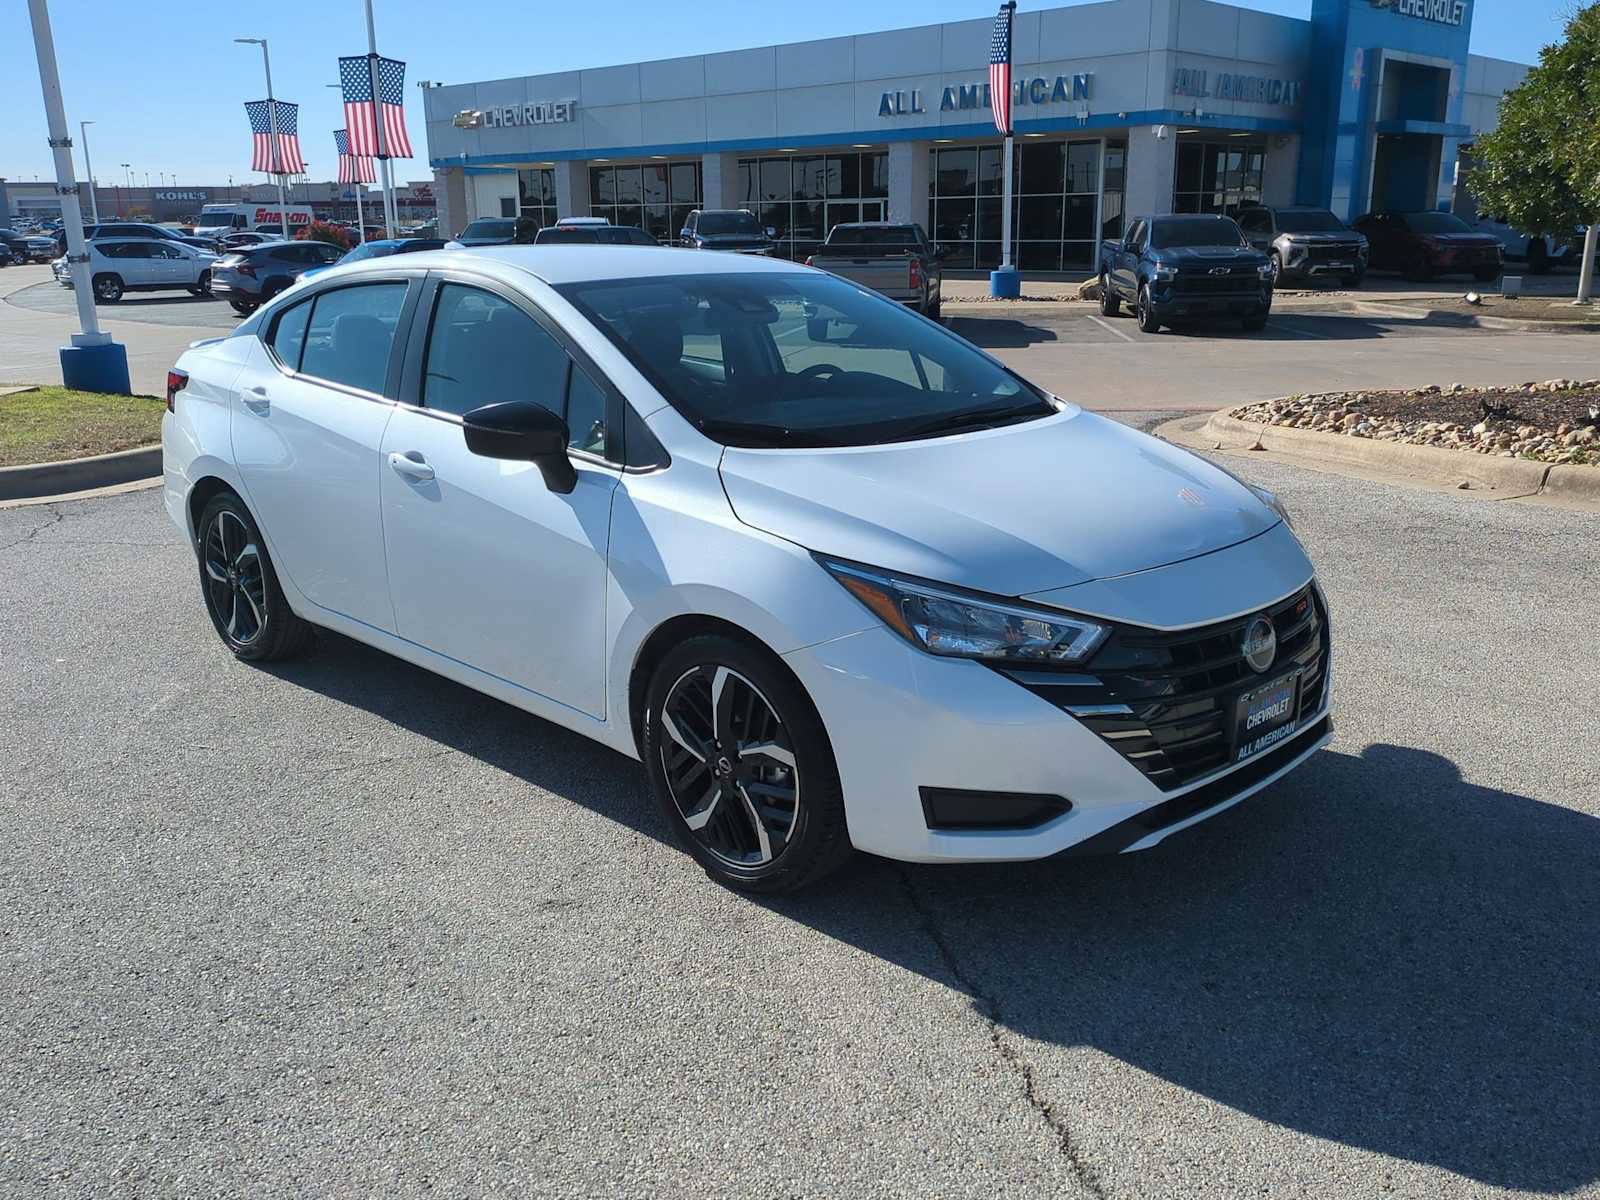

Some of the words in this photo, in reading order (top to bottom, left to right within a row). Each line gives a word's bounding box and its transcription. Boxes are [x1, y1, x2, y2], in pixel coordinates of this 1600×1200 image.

[1399, 0, 1466, 26] CHEVROLET
[1174, 68, 1209, 97] ALL
[483, 100, 576, 128] CHEVROLET
[878, 89, 924, 116] ALL
[155, 192, 207, 200] KOHL'S
[1246, 698, 1290, 730] CHEVROLET
[1238, 742, 1253, 760] ALL
[1254, 720, 1296, 752] AMERICAN
